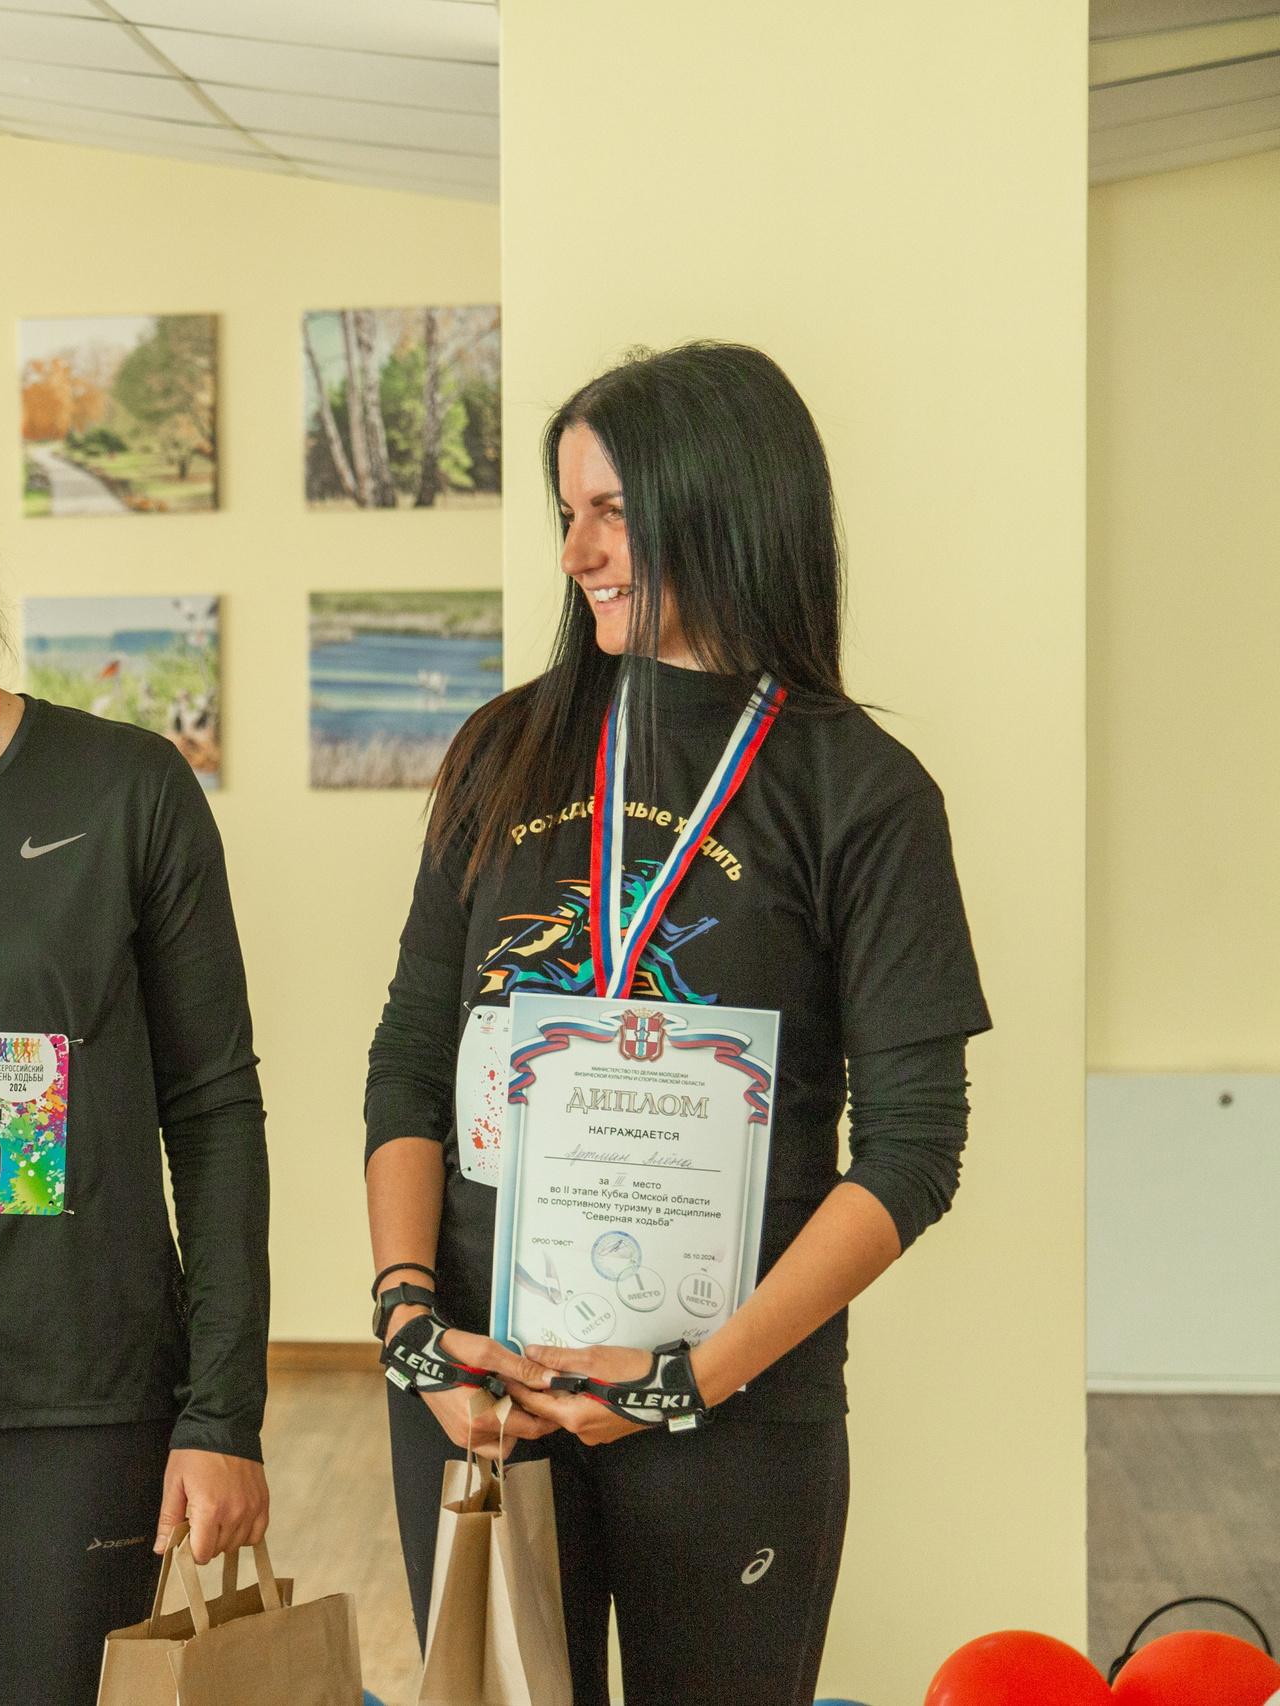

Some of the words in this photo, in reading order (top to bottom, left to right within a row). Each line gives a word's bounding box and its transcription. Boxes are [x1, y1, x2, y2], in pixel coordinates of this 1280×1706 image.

[673, 815, 742, 883] хдить
[591, 1066, 631, 1074] МИНИСТЕРСТВО
[14, 1072, 44, 1083] ХОДЬБЫ
[658, 1077, 681, 1085] ОМСКОЙ
[9, 1083, 27, 1092] 2024
[565, 1086, 710, 1119] ДИПЛОМ
[588, 1125, 680, 1141] НАГРАЖДАЕТСЯ
[598, 1177, 610, 1186] за
[632, 1180, 662, 1190] место
[549, 1185, 561, 1194] во
[563, 1185, 570, 1195] II
[571, 1188, 599, 1198] этапе
[601, 1190, 629, 1201] Кубка
[631, 1191, 669, 1203] Омской
[670, 1195, 711, 1206] области
[537, 1197, 549, 1205] по
[550, 1197, 612, 1212] спортивному
[614, 1203, 653, 1215] туризму
[655, 1206, 661, 1214] в
[663, 1207, 722, 1219] дисциплине
[582, 1211, 633, 1224] "Северная
[635, 1216, 674, 1227] ходьба"
[531, 1237, 551, 1245] ОРОО
[551, 1239, 574, 1247] "ОФСТ"
[683, 1252, 716, 1261] 05.10.2024
[627, 1289, 661, 1301] МЕСТО
[685, 1295, 718, 1308] МЕСТО
[581, 1312, 611, 1336] МЕСТО
[393, 1345, 440, 1377] LEKI
[626, 1392, 691, 1409] LEKI
